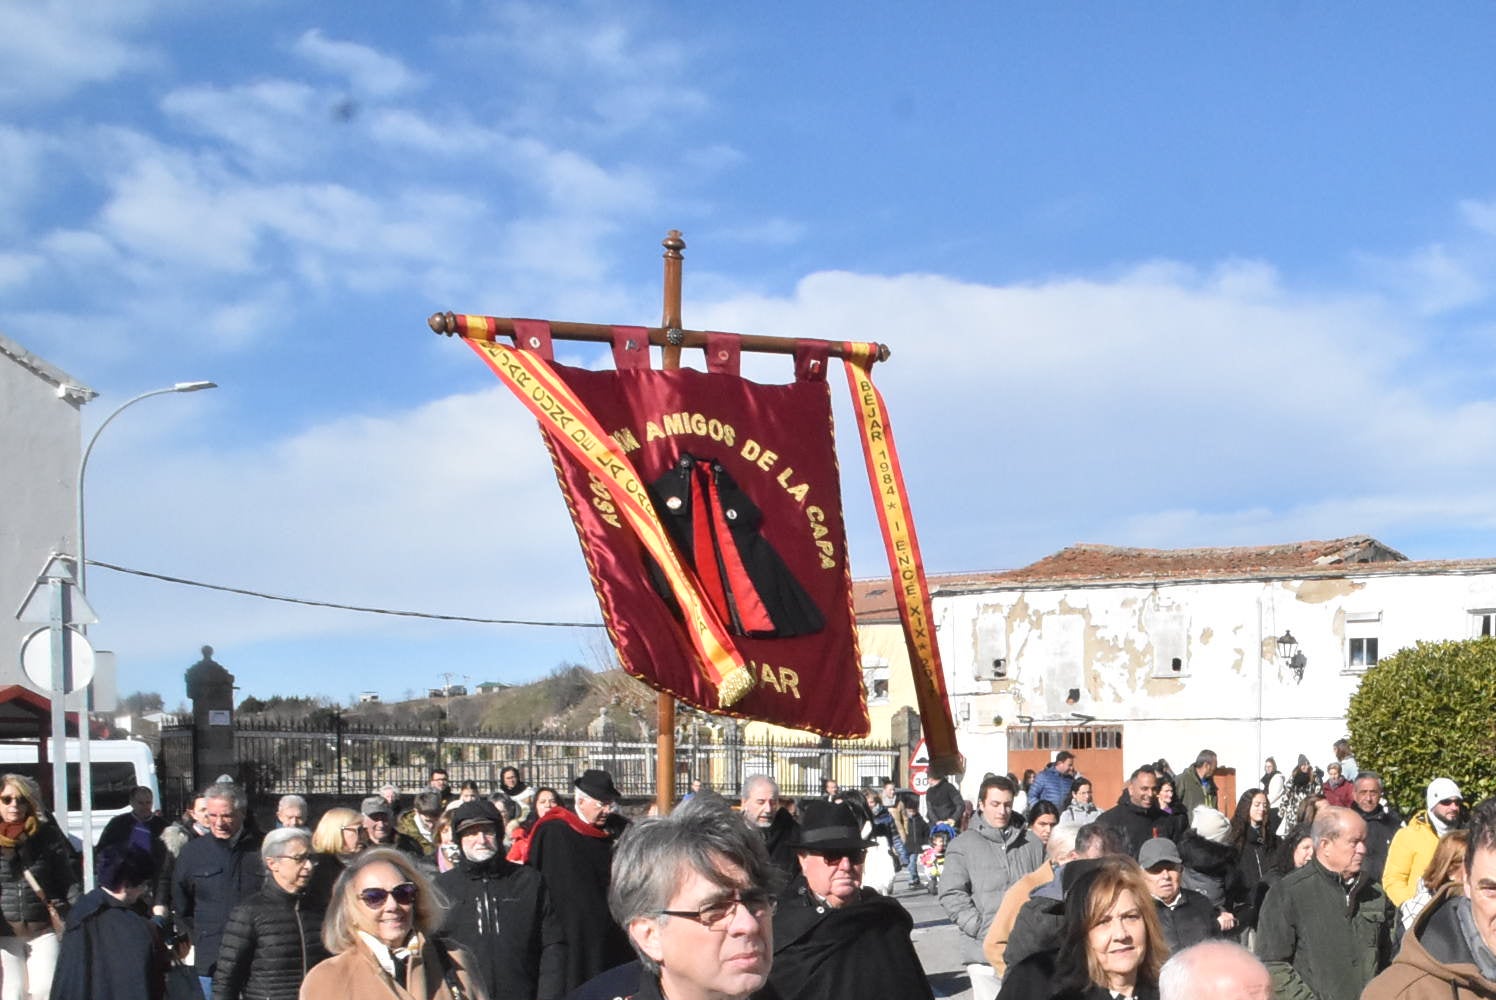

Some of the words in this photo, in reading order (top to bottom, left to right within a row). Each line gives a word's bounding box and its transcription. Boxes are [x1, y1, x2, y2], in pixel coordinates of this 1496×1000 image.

[532, 386, 573, 429] CUNA
[571, 429, 596, 451] DE
[596, 456, 625, 479] LA
[646, 412, 735, 447] AMIGOS
[740, 439, 779, 471] DE
[776, 467, 809, 502] LA
[805, 505, 836, 570] CAPA
[879, 450, 896, 496] 1984
[911, 606, 927, 640] XIX
